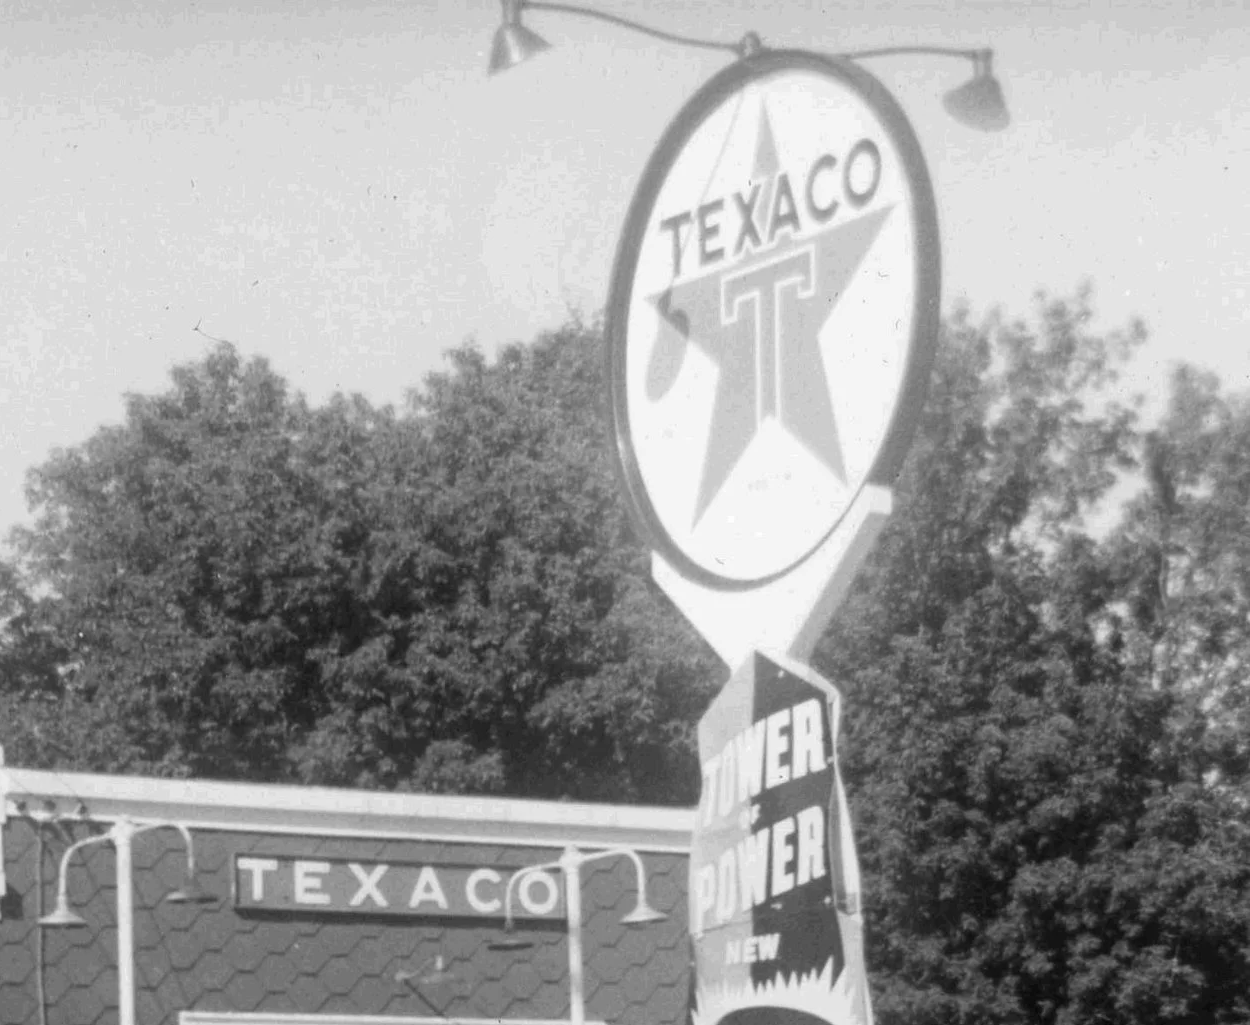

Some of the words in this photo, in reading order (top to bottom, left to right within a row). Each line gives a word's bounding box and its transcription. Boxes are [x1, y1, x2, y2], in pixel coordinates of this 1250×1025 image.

[659, 138, 883, 278] TEXACO
[701, 697, 828, 828] TOWER
[236, 856, 559, 916] TEXACO
[693, 804, 827, 940] POWER
[725, 932, 781, 965] NEW
